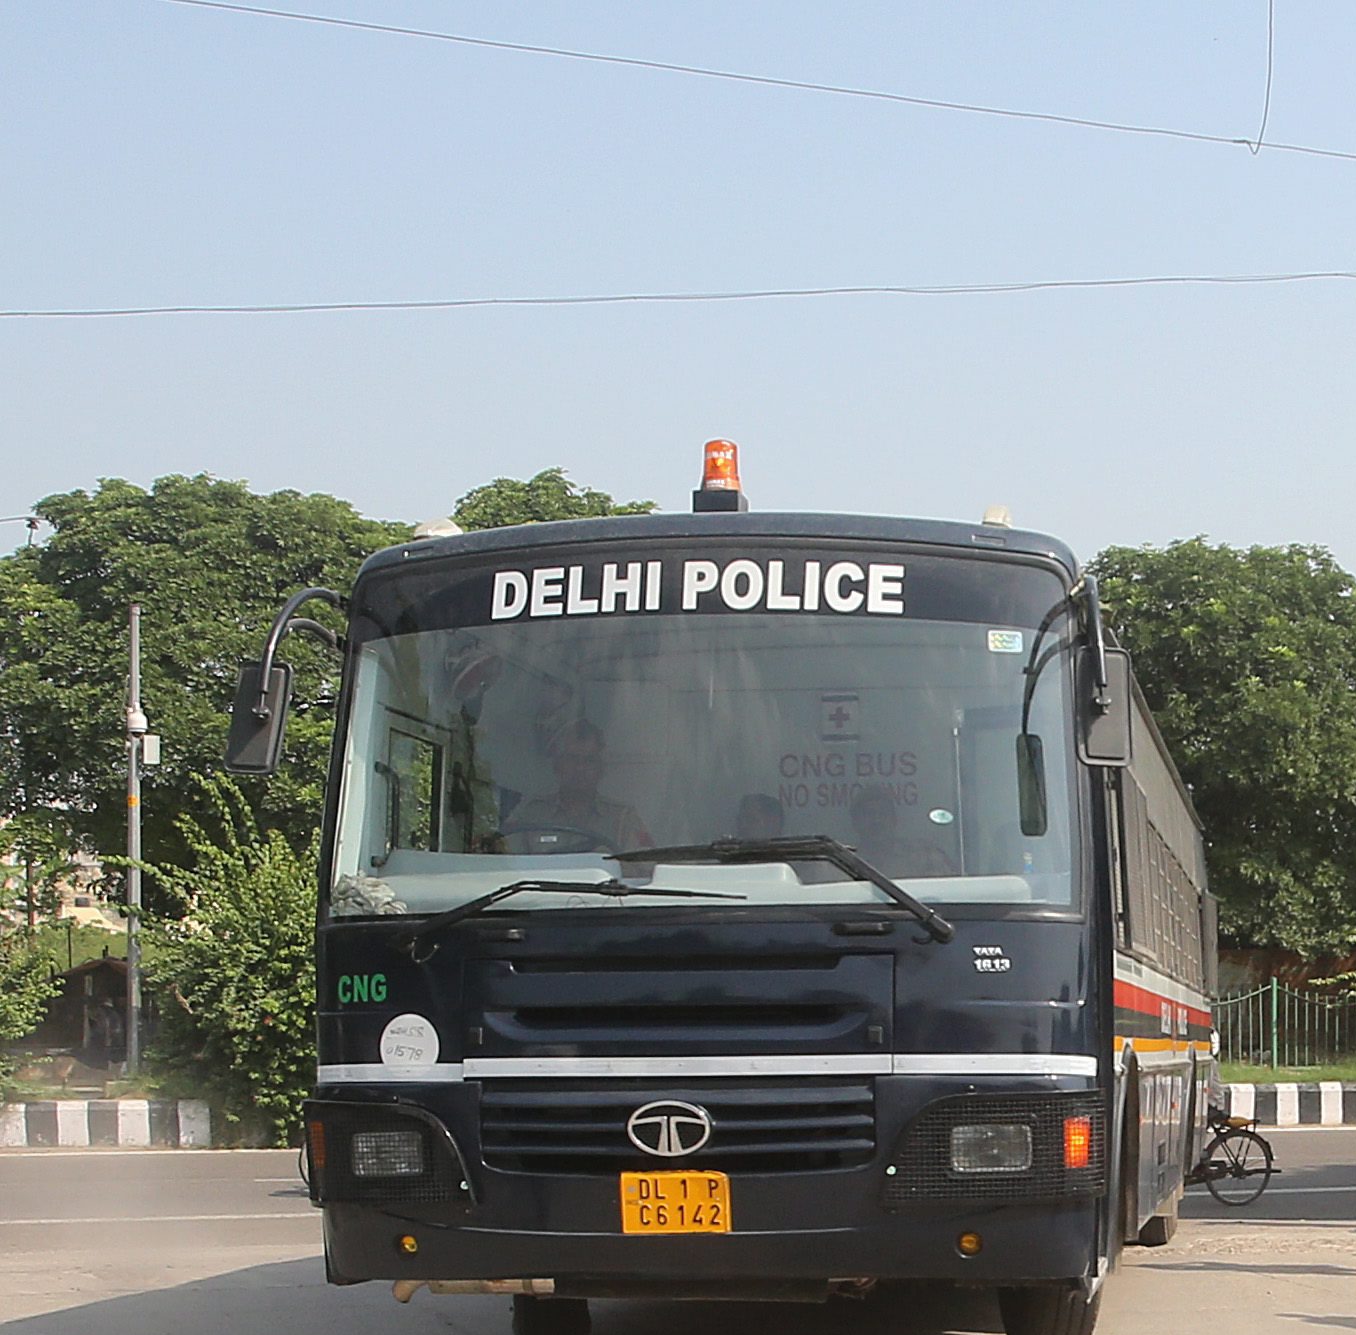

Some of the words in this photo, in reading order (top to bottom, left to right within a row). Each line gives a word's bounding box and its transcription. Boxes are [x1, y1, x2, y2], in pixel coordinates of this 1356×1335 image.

[490, 560, 662, 621] DELHI
[680, 558, 907, 615] POLICE
[779, 753, 846, 779] CNG
[855, 751, 918, 777] BUS
[779, 784, 809, 808] NO
[972, 946, 1004, 957] TATA
[338, 973, 387, 1004] CNG
[639, 1178, 666, 1200] DL
[680, 1178, 688, 1199] 1
[707, 1178, 720, 1199] P
